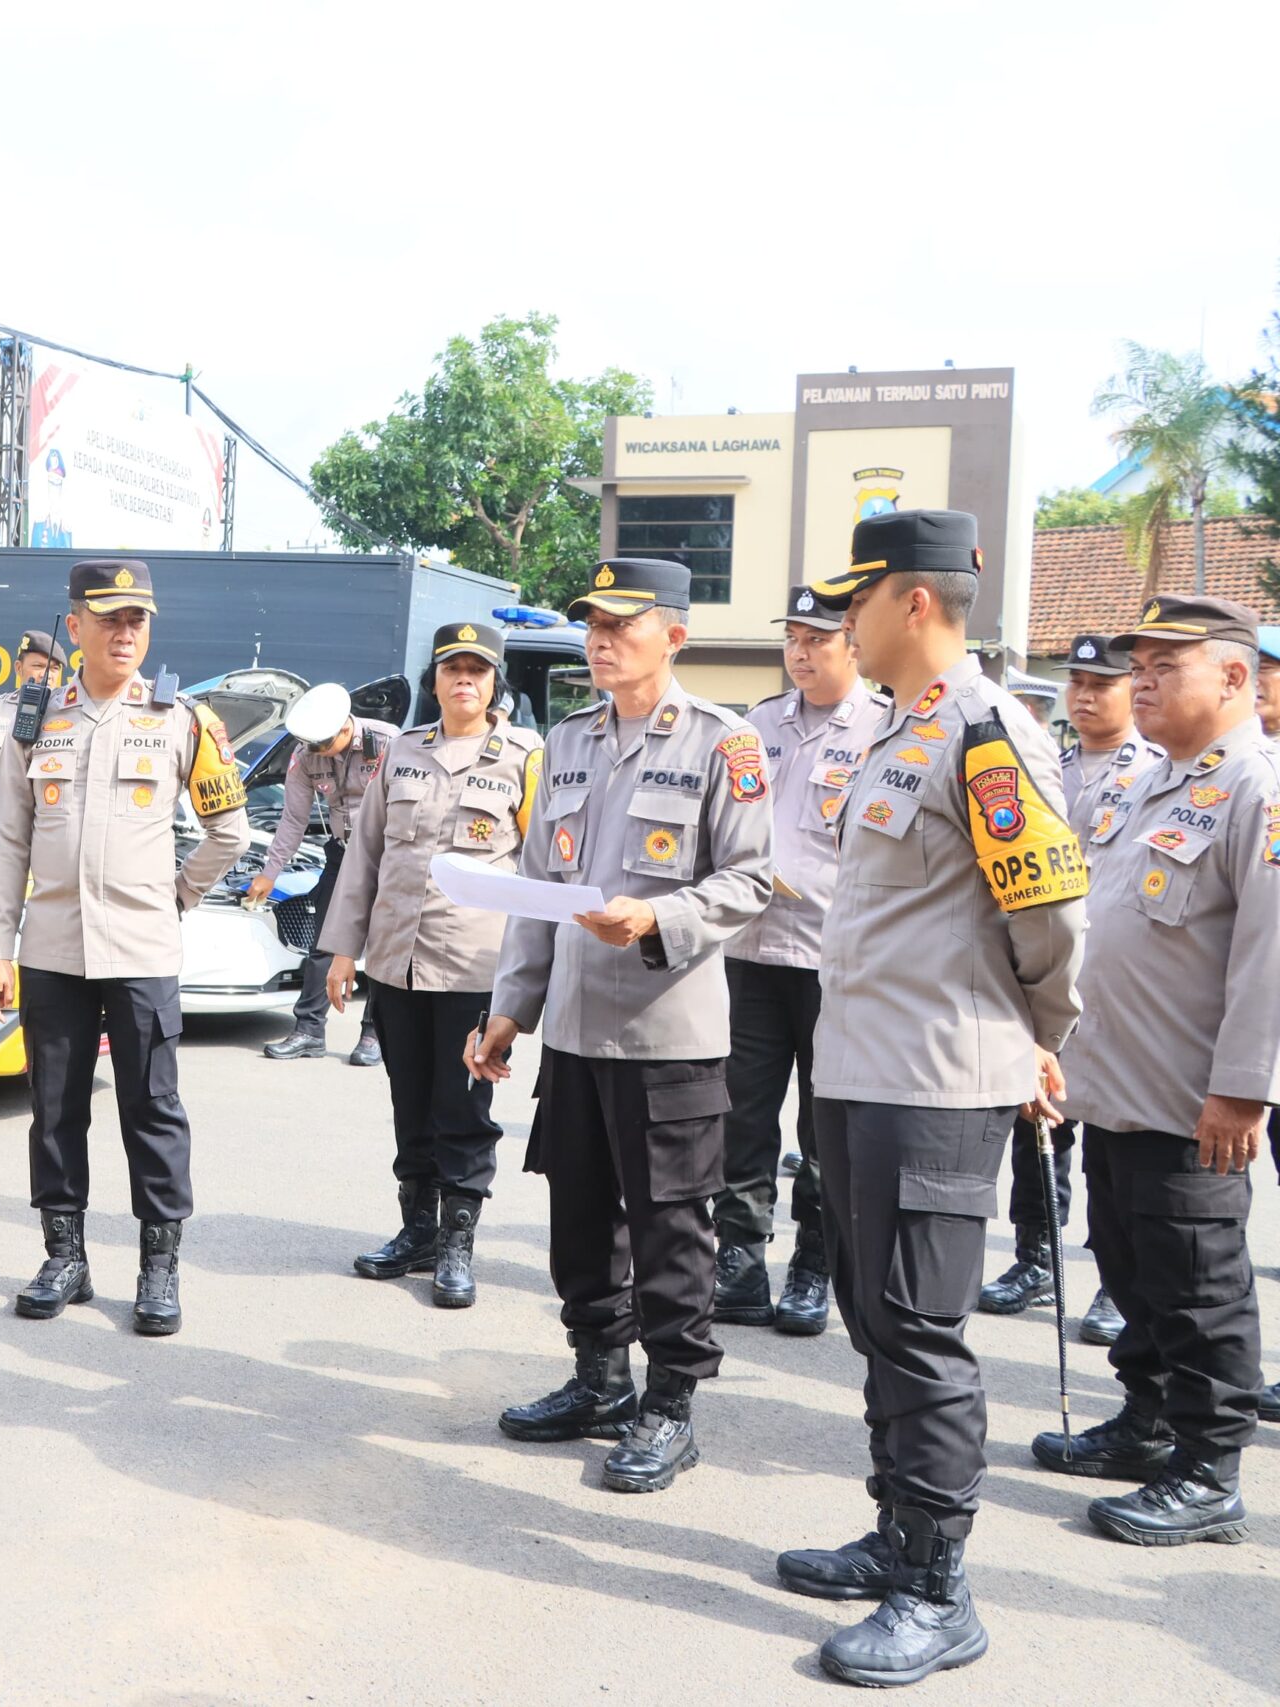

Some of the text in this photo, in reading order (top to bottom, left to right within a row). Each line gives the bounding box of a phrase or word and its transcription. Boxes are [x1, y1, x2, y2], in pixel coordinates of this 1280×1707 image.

[802, 382, 1009, 404] PELAYANAN TERPADU SATU PINTU
[86, 428, 193, 480] APEL PEMBERIAN PENGHARGAAN
[625, 439, 781, 454] WICAKSANA LAGHAWA
[73, 449, 103, 476] KEPADA
[104, 461, 138, 488] ANGGOTA
[138, 472, 165, 497] POLRES
[108, 489, 129, 510] YANG
[35, 737, 75, 749] DODIK
[123, 737, 166, 749] POLRI
[393, 766, 431, 781] NENY
[552, 771, 587, 788] KUS
[641, 770, 702, 790] POLRI
[880, 767, 922, 793] POLRI
[196, 775, 232, 800] WAKA
[466, 776, 513, 796] POLRI
[201, 798, 222, 812] OMP
[1167, 807, 1217, 832] POLRI
[992, 851, 1042, 890] OPS
[1003, 883, 1053, 905] SEMERU
